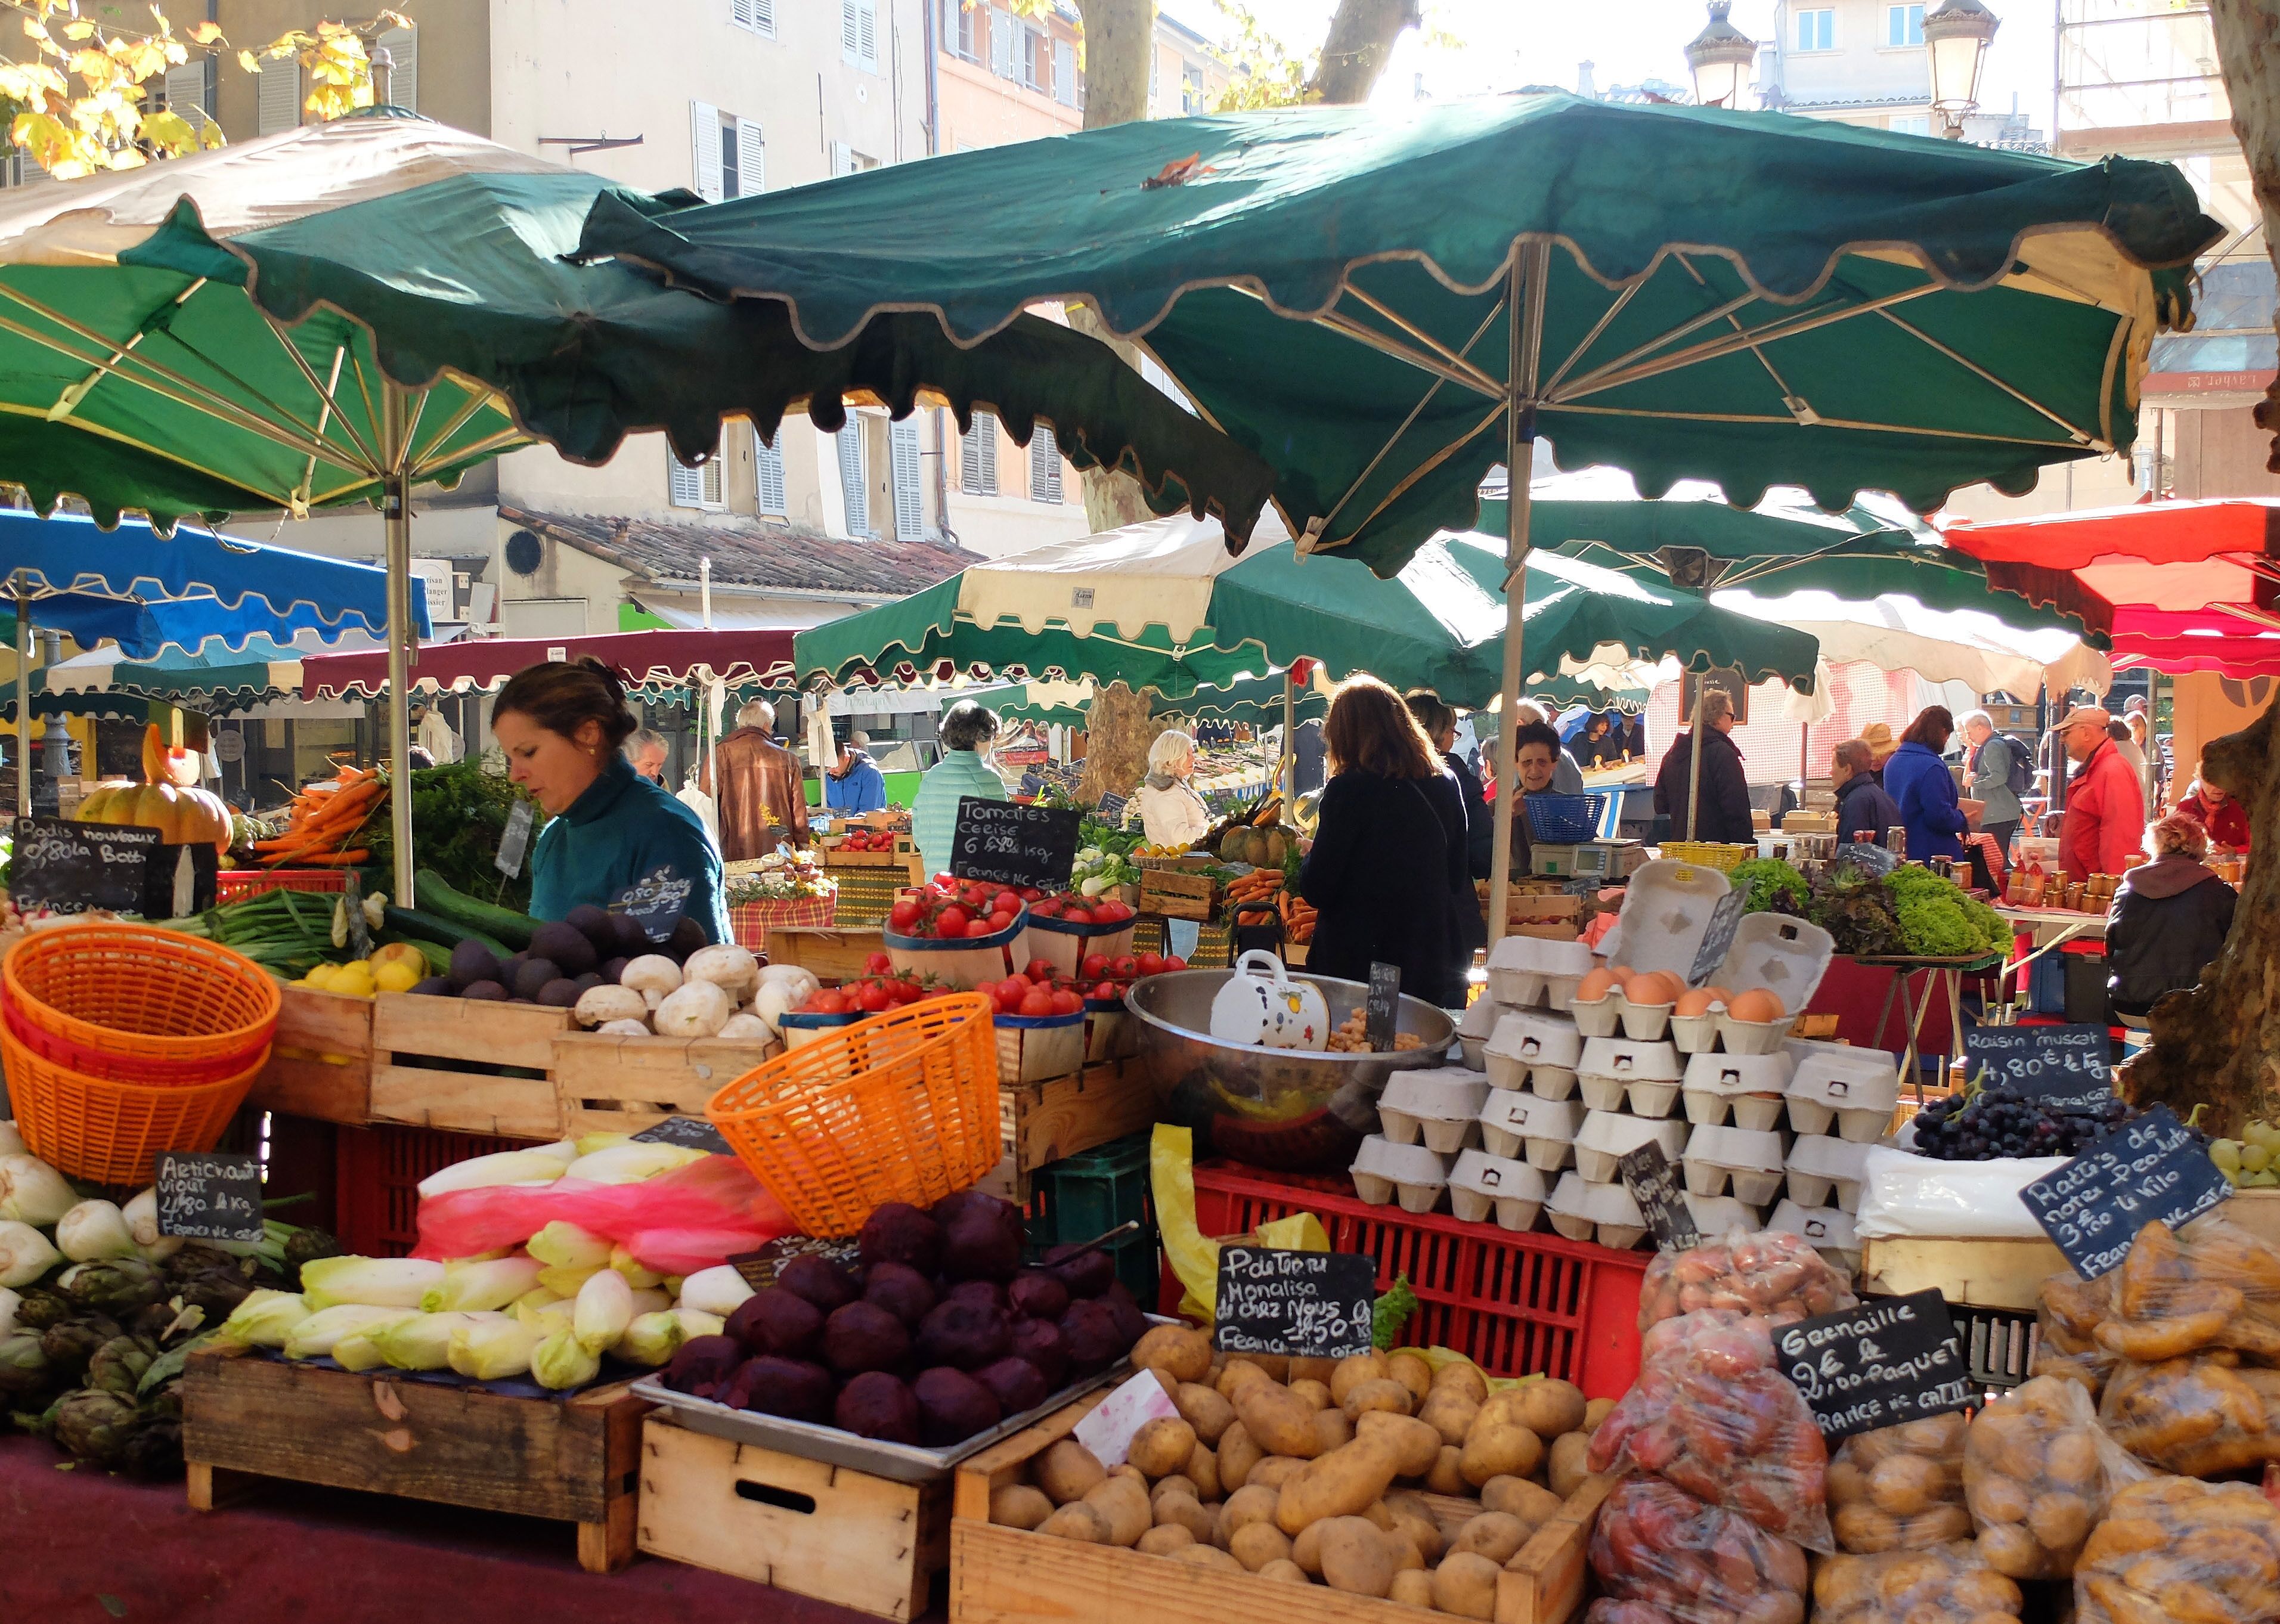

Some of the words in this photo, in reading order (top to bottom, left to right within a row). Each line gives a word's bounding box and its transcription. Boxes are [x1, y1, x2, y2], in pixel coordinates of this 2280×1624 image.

[1968, 1033, 2027, 1049] Raisin
[2036, 1031, 2099, 1047] muscat
[1238, 1300, 1281, 1319] chez
